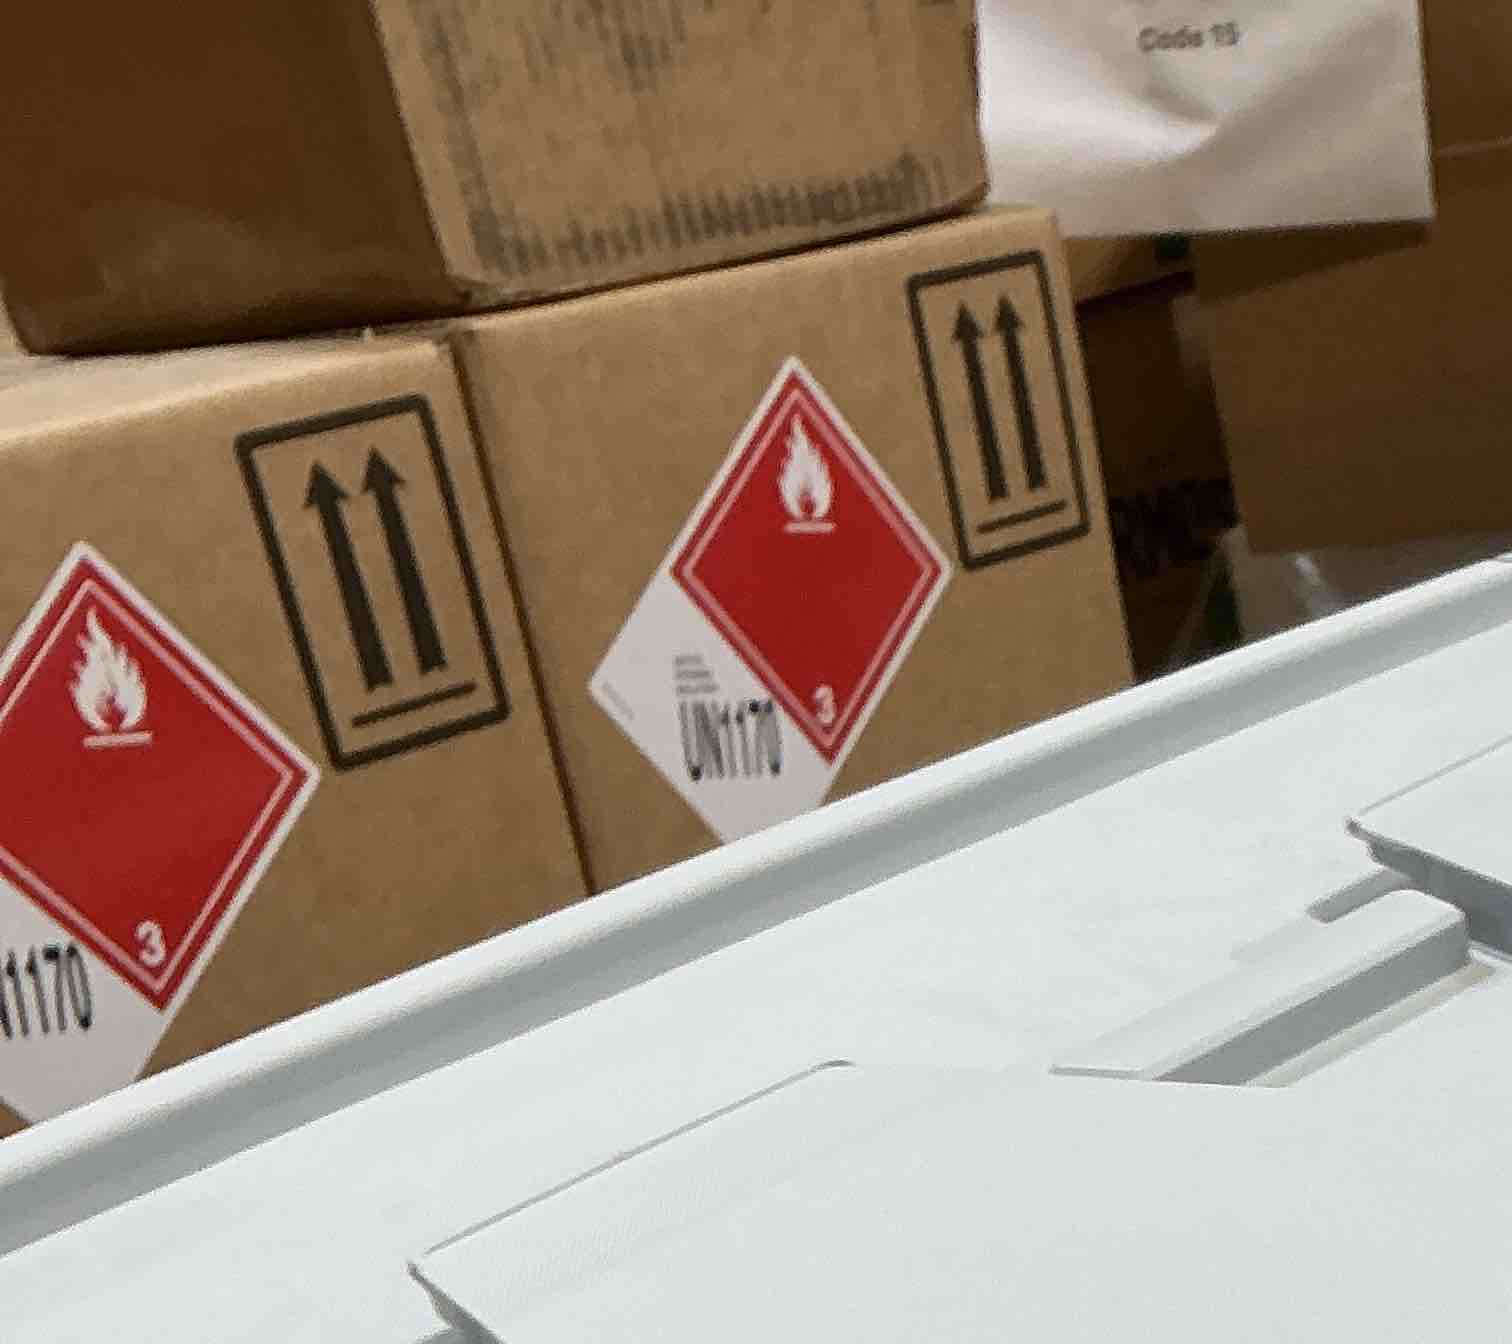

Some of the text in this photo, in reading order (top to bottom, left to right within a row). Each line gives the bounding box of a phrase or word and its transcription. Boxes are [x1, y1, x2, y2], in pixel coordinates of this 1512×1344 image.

[813, 682, 838, 730] 3
[675, 698, 783, 782] UN1170
[134, 918, 168, 968] 3
